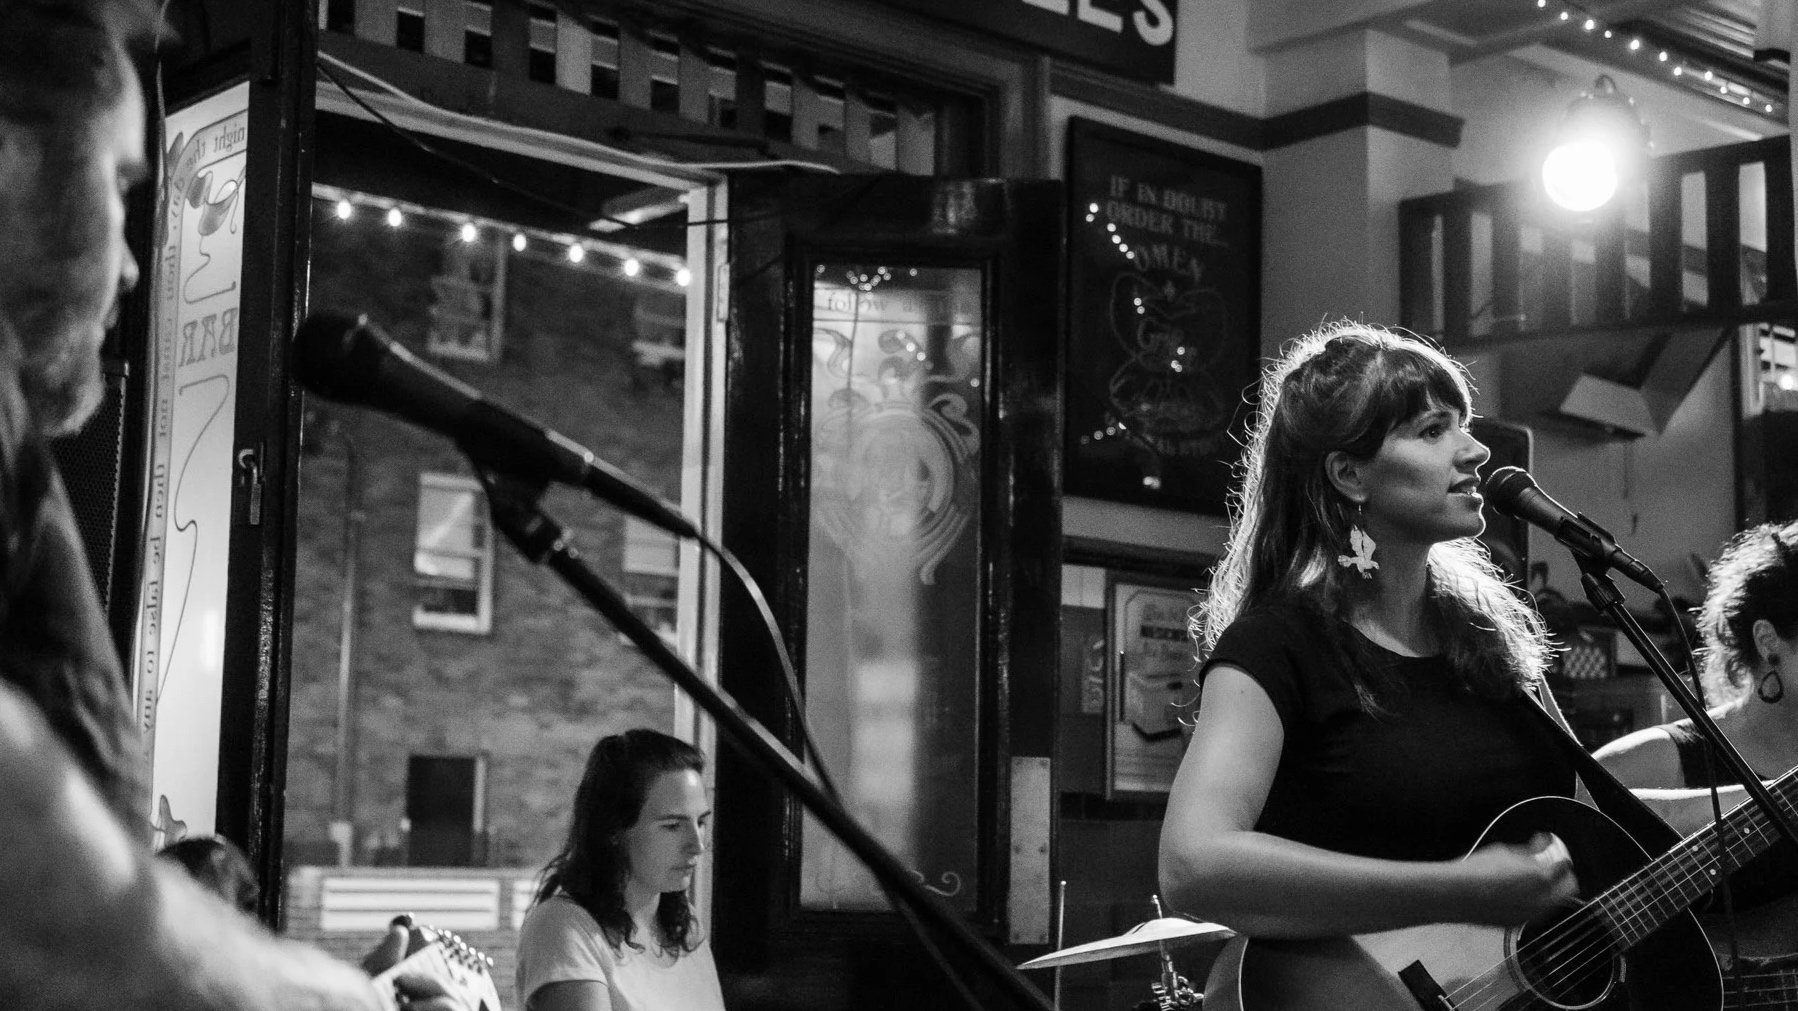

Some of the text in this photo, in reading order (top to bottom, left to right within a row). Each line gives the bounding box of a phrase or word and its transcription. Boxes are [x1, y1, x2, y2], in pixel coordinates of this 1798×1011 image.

[1106, 200, 1173, 235] ORDER
[1110, 175, 1228, 221] IF IN DOUBT
